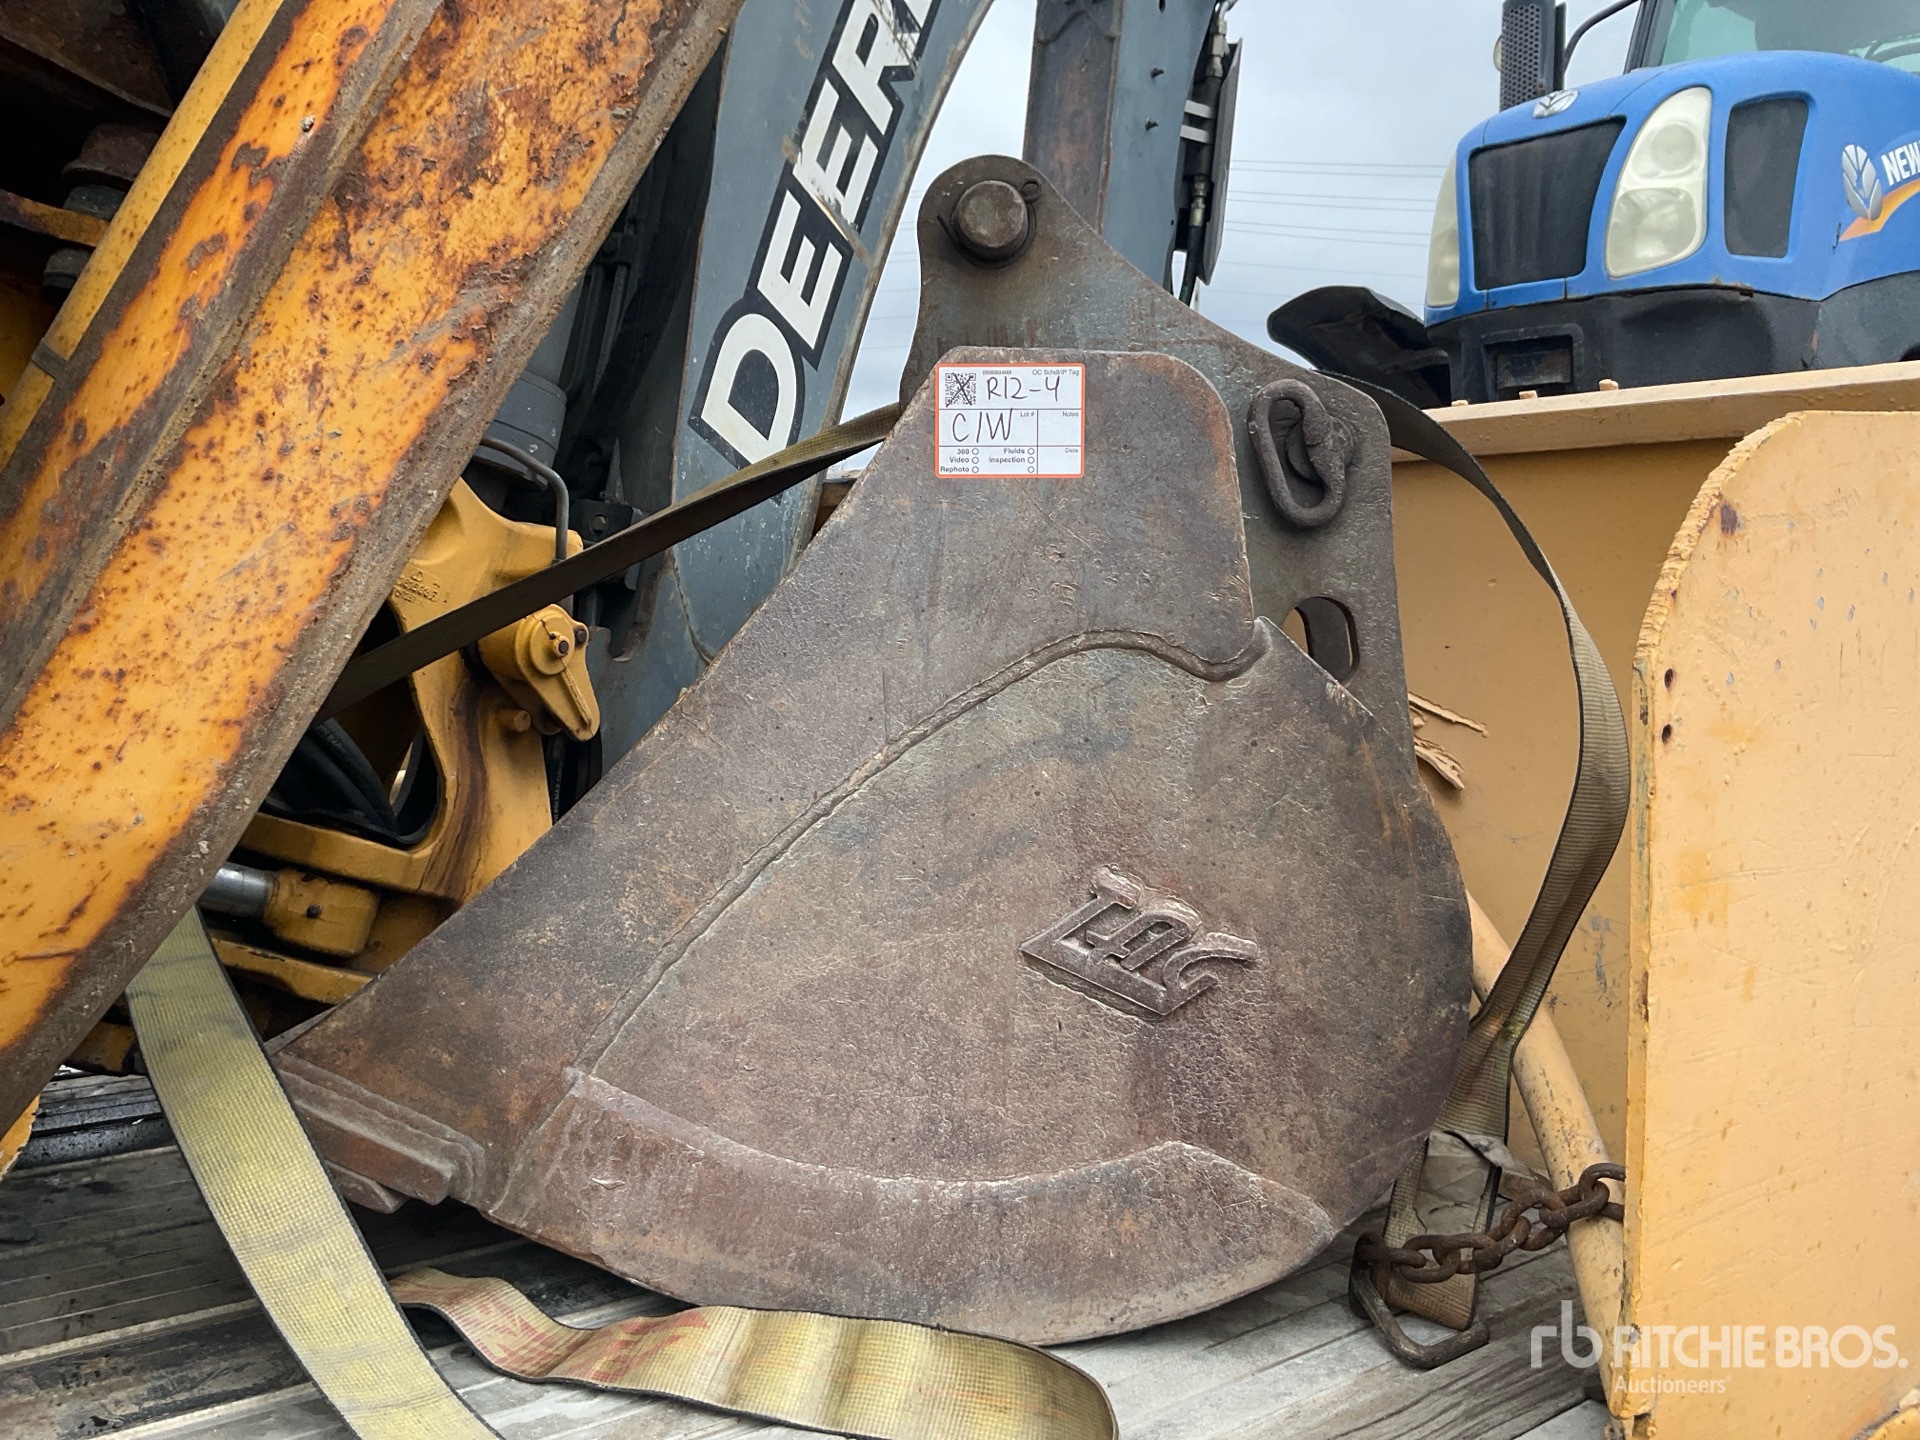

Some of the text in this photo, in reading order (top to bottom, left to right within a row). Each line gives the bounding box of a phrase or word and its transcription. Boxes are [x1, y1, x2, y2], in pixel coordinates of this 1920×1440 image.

[1881, 140, 1920, 187] NEW
[700, 0, 933, 465] DEER
[1069, 369, 1079, 377] Tag
[986, 375, 1060, 401] R12-4
[988, 456, 1026, 464] Inspection
